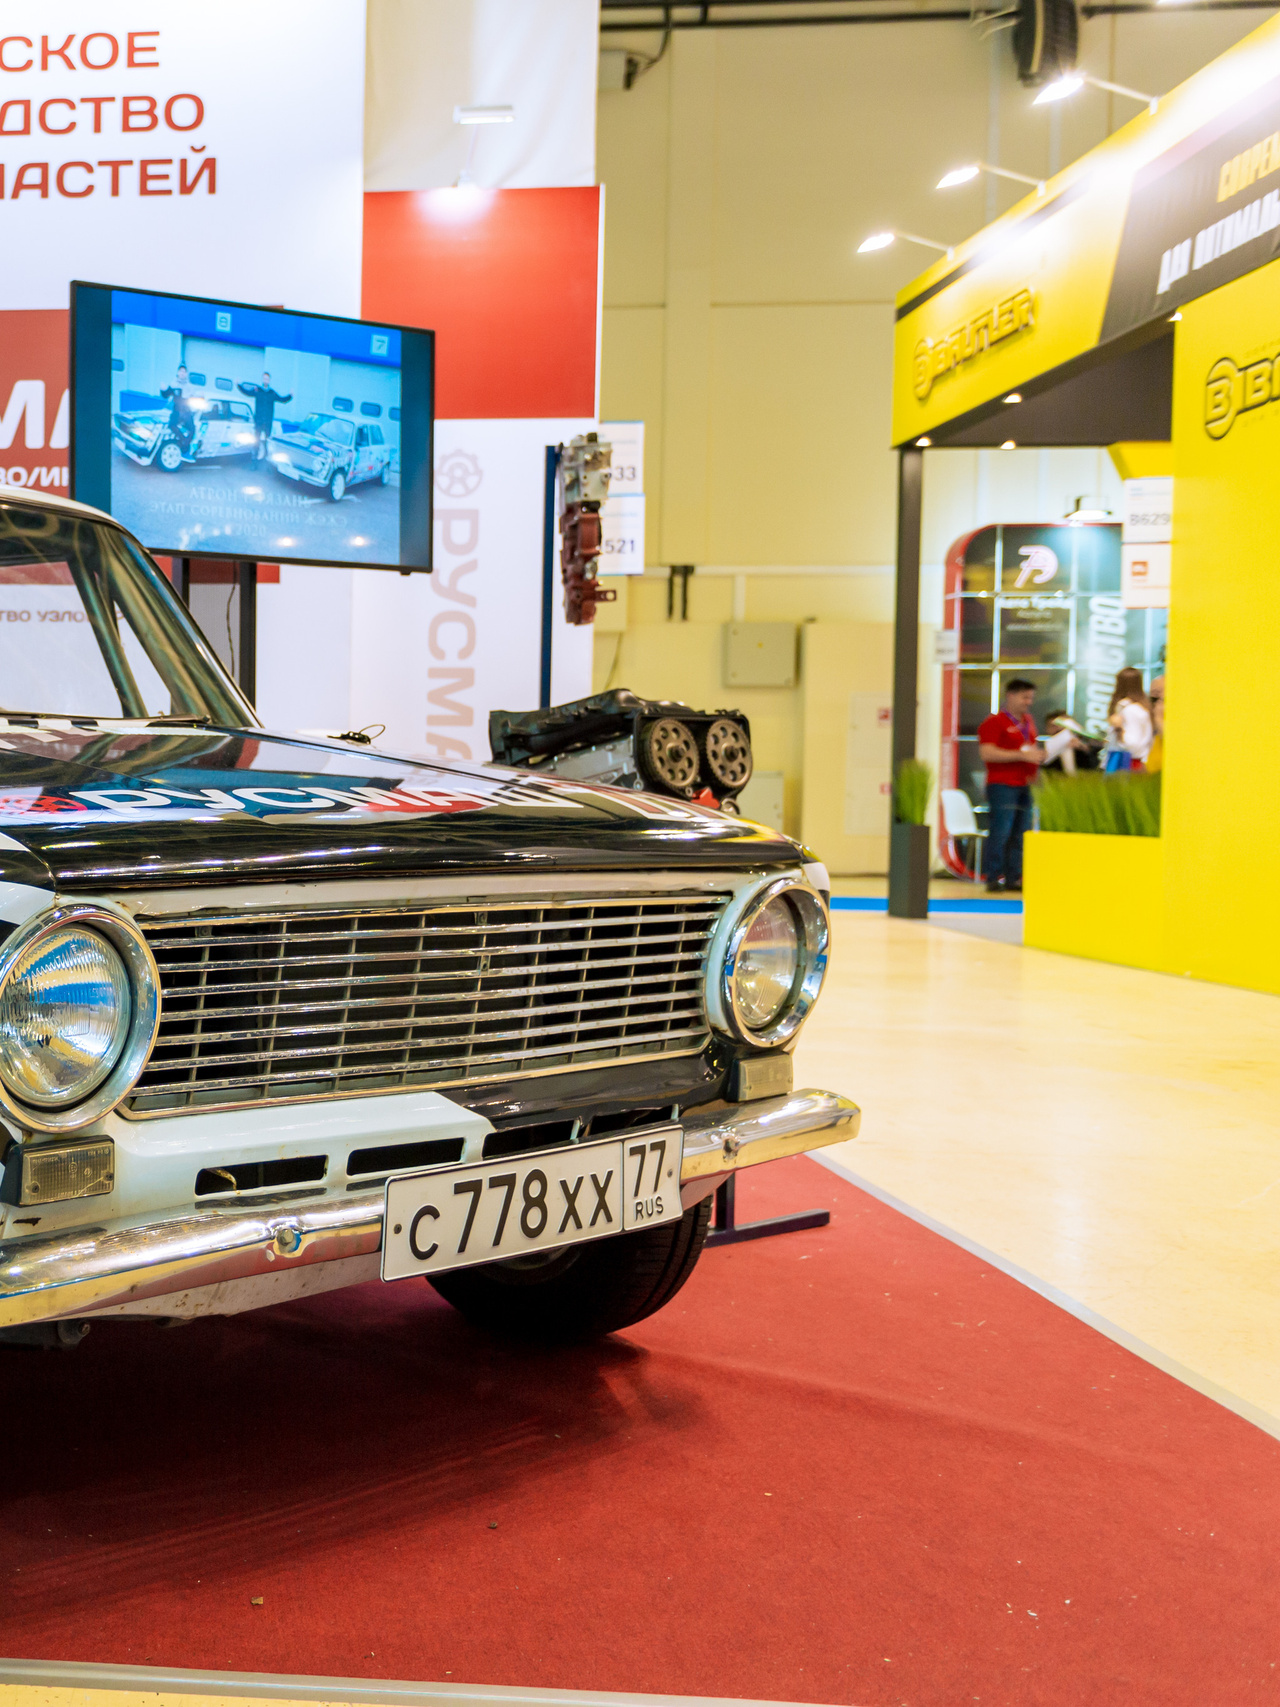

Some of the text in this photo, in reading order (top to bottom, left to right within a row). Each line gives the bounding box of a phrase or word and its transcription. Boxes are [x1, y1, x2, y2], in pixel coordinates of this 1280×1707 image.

[37, 609, 91, 623] УЗЛО
[628, 1139, 667, 1198] 77
[634, 1194, 665, 1221] RUS
